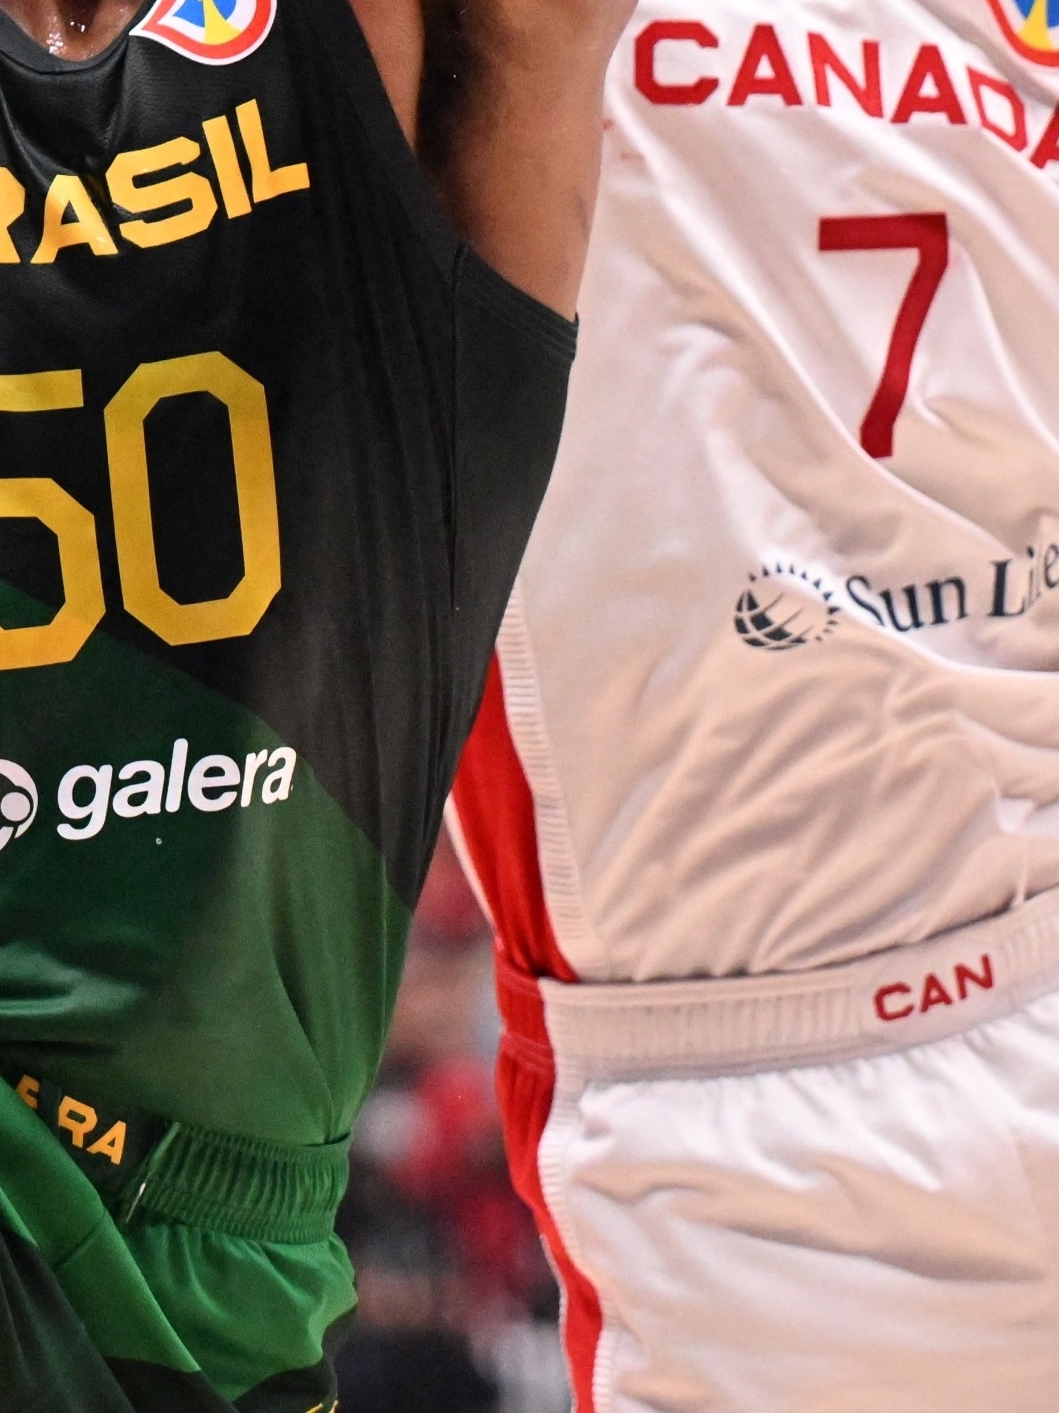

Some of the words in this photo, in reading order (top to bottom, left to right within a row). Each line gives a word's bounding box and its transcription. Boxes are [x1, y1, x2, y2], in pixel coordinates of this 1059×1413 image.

[818, 212, 949, 459] 7
[846, 572, 968, 633] Sun
[57, 738, 297, 840] galera
[873, 954, 995, 1023] CAN
